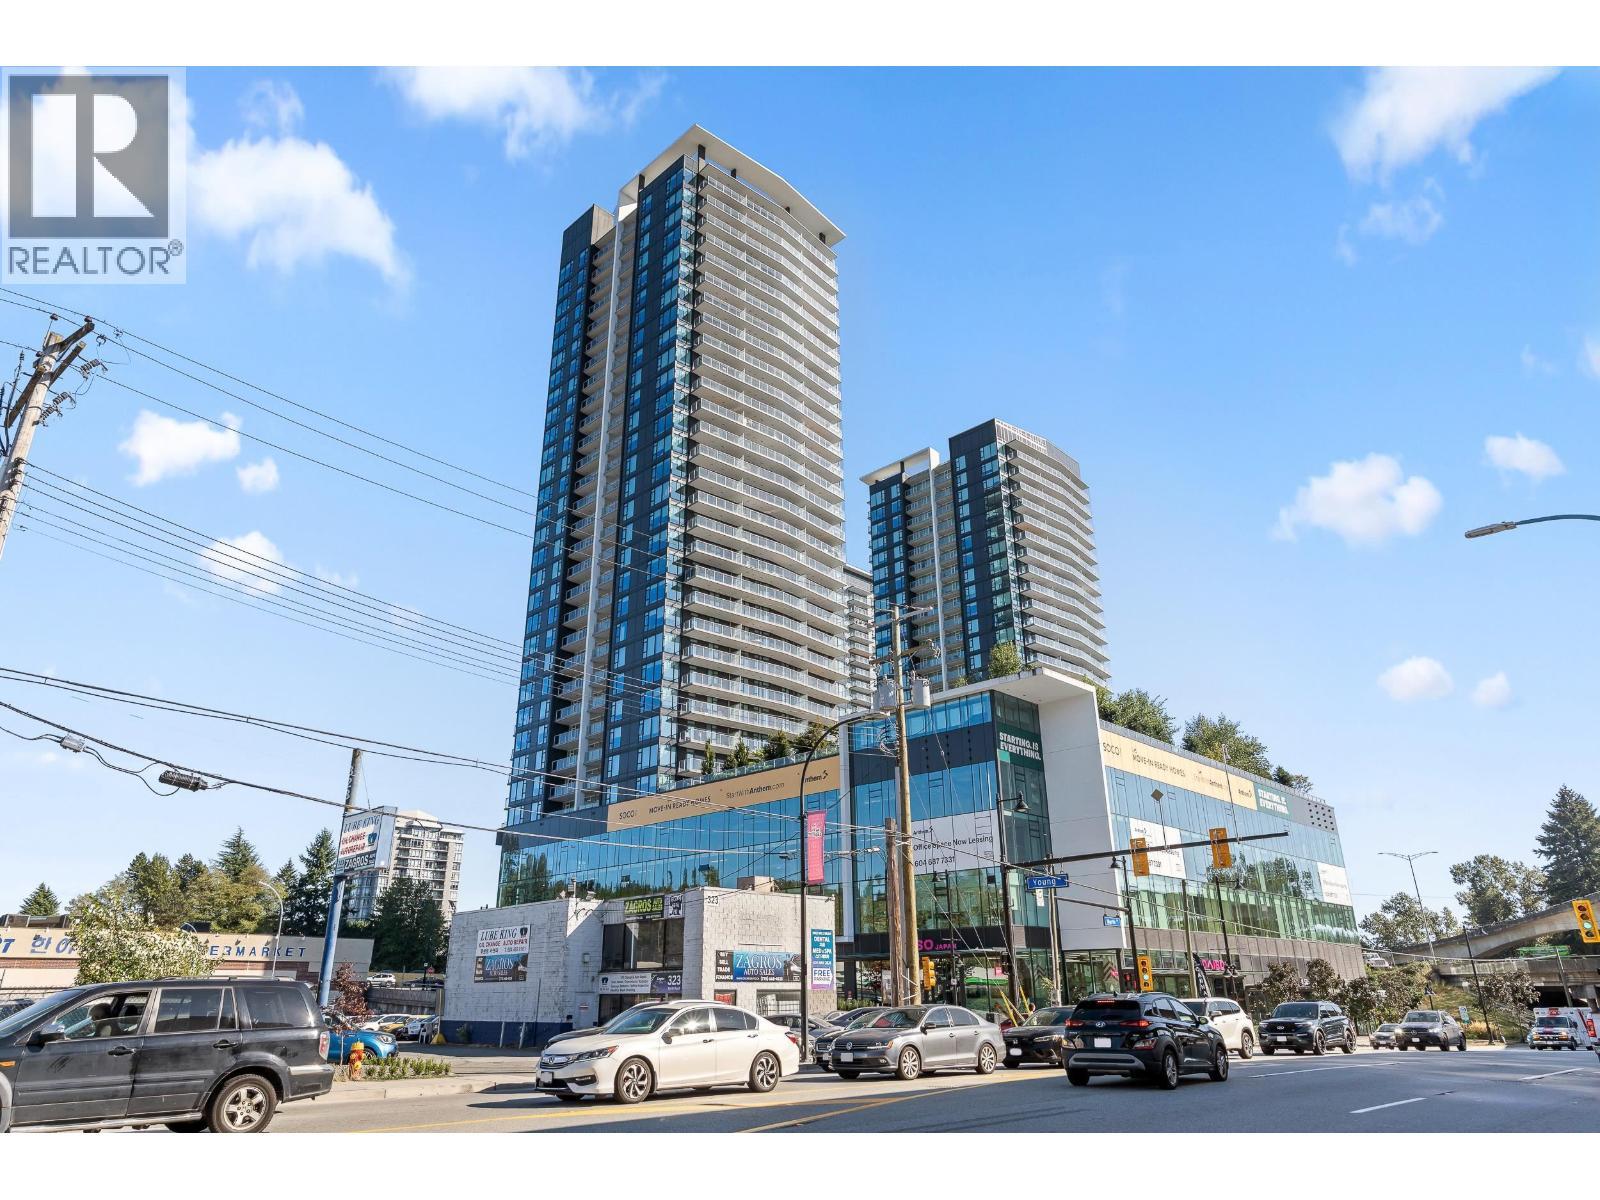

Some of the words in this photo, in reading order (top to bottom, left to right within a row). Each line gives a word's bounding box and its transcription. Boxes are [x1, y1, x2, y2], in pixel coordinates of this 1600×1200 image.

[913, 843, 931, 851] Office
[953, 838, 967, 846] Now
[968, 835, 993, 844] Leasing
[1032, 878, 1056, 887] Young
[624, 899, 652, 913] ZAGROS
[707, 895, 719, 905] 323
[736, 954, 782, 969] ZAGROS
[667, 974, 681, 986] 323
